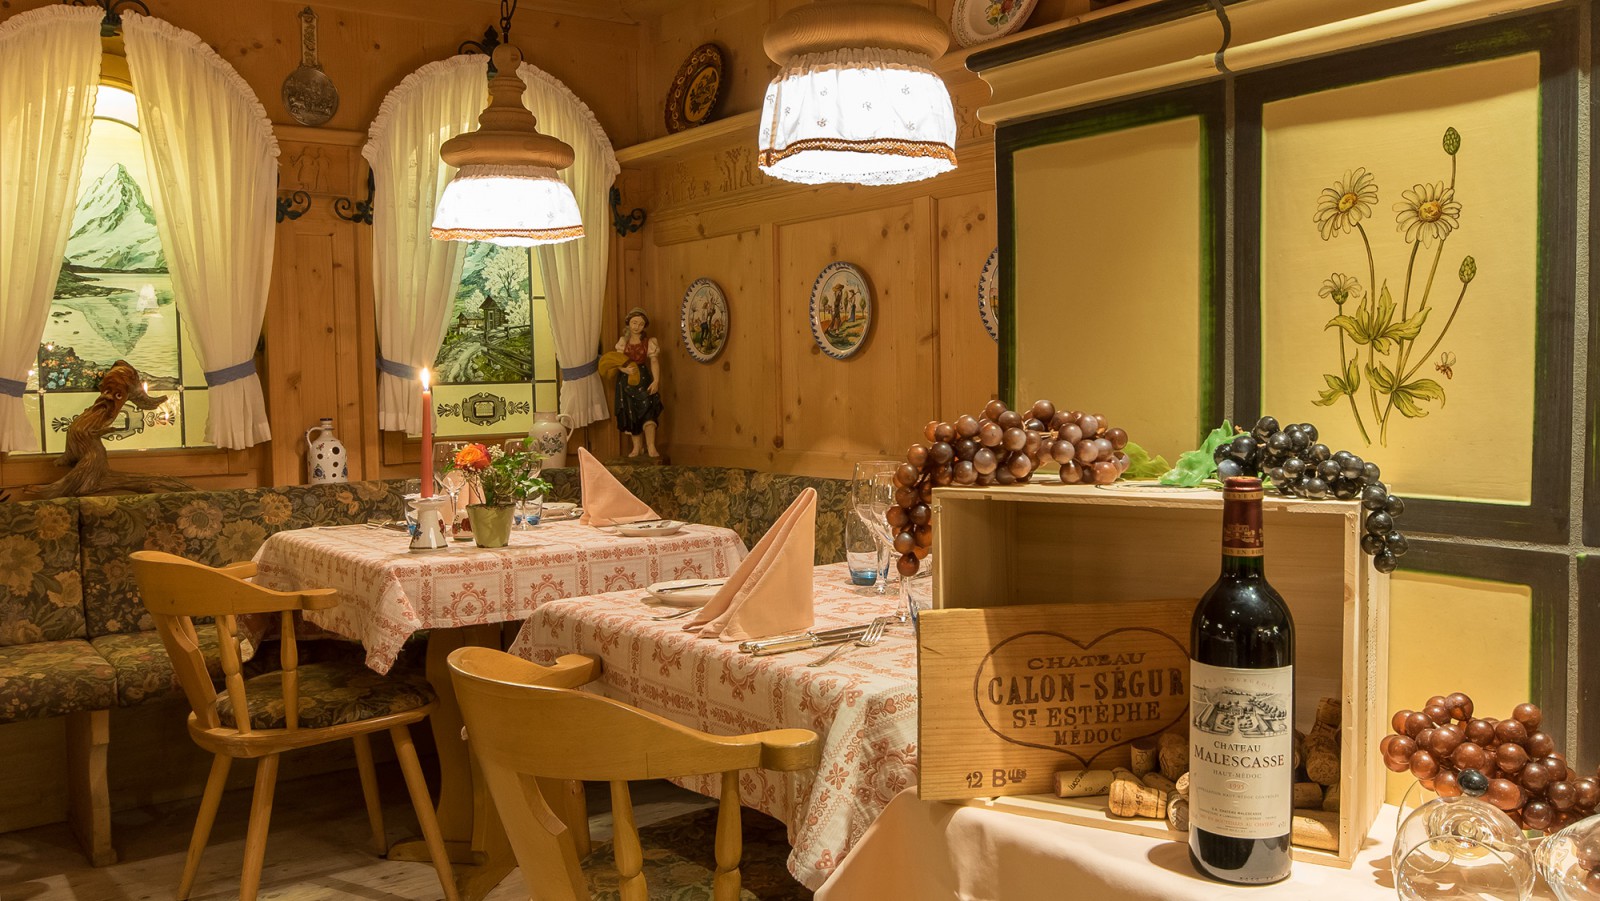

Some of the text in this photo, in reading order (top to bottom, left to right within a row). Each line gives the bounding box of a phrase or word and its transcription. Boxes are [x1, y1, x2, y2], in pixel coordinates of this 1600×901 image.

[1027, 652, 1146, 670] CHATEAU
[988, 666, 1184, 706] CALON-SÉGUR
[1046, 701, 1160, 727] ESTÈPHE
[1054, 726, 1121, 746] MÉDOC
[1194, 744, 1285, 769] MALESCASSE
[1213, 740, 1262, 753] CHATEAU
[966, 771, 983, 788] 12
